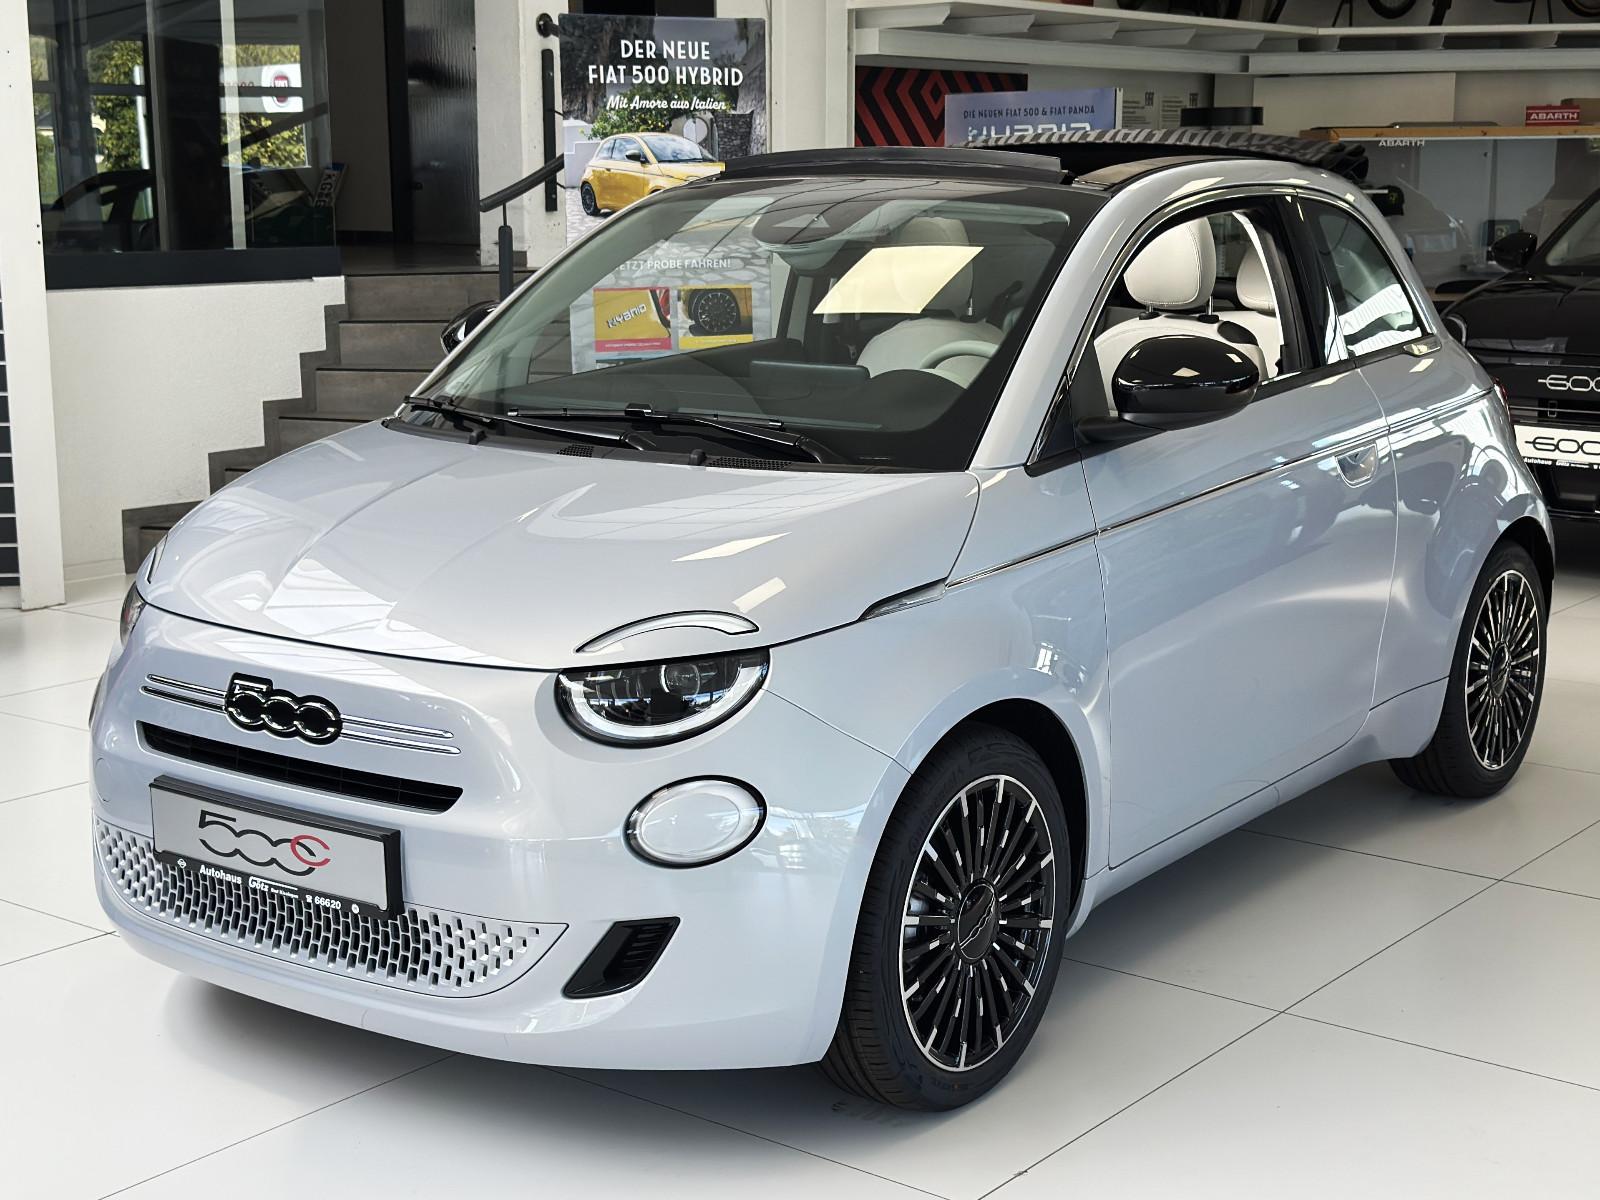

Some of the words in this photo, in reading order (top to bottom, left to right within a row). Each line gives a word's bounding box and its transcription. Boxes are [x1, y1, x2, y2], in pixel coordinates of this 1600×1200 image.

[620, 39, 656, 59] DER
[663, 40, 710, 60] NEUE
[588, 65, 627, 84] FIAT
[632, 65, 669, 85] 500
[676, 66, 744, 87] HYBRID
[606, 95, 629, 110] Mit
[629, 95, 669, 110] Amore
[670, 96, 689, 109] aus
[691, 96, 726, 110] Italien
[963, 110, 976, 119] DIE
[979, 109, 1003, 119] NEUEN
[1005, 108, 1022, 118] FIAT
[1023, 107, 1039, 117] 500
[1041, 107, 1048, 116] &
[1050, 106, 1066, 116] FIAT
[1068, 105, 1095, 115] PANDA
[1530, 112, 1578, 120] ABARTH
[1378, 138, 1425, 147] ABARTH
[647, 259, 682, 270] PROBE
[684, 258, 731, 269] FAHREN!
[226, 673, 340, 743] 500
[200, 864, 242, 885] Autohaus
[314, 895, 342, 910] 66620
